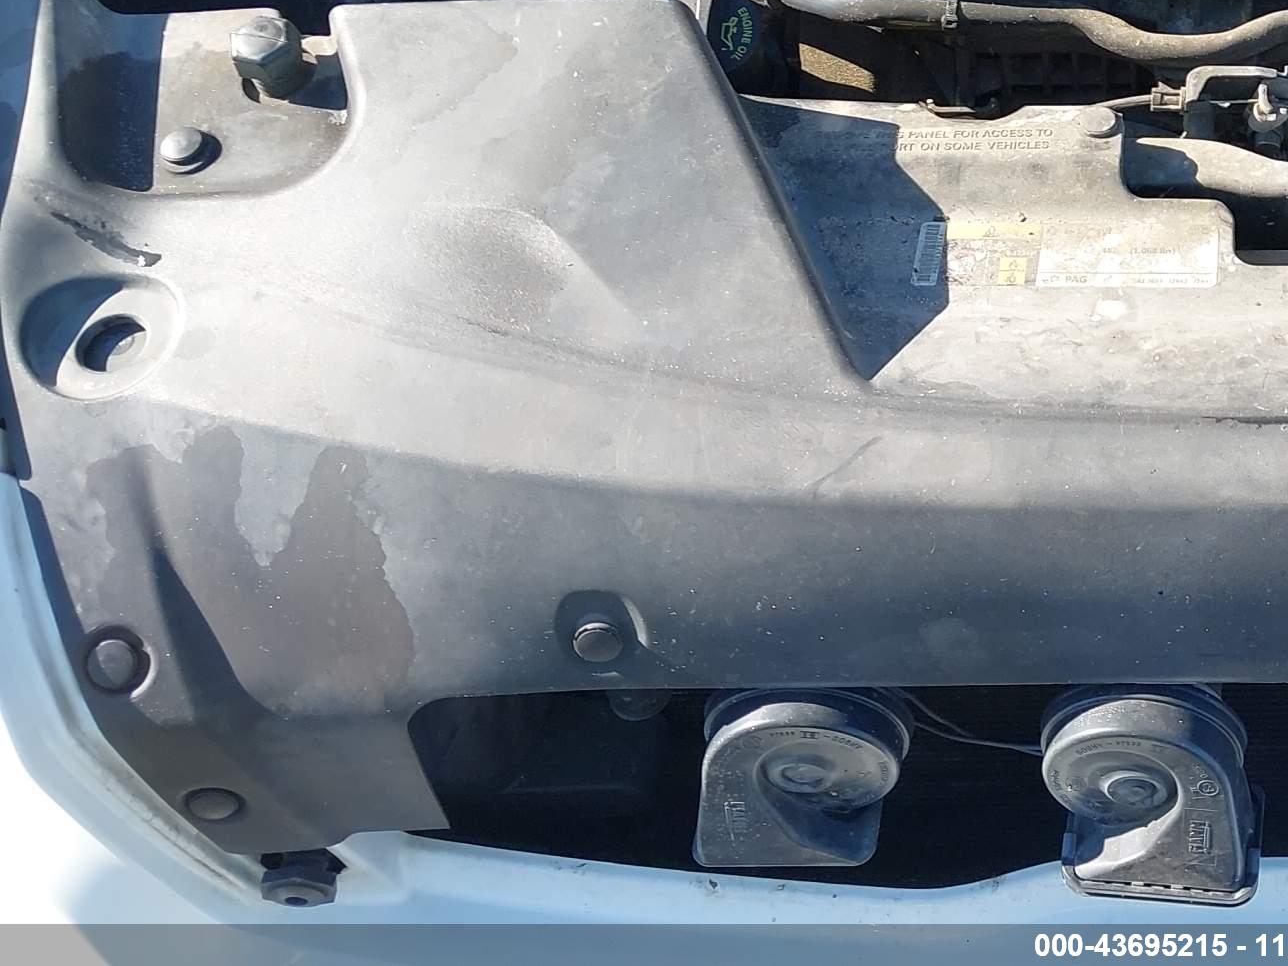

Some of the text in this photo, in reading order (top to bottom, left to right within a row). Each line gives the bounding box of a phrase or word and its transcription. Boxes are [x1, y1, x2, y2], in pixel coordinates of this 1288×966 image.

[730, 6, 753, 61] ENGINE OIL
[908, 130, 950, 139] PANEL
[953, 129, 979, 139] FOR
[982, 129, 1033, 138] ACCESS
[1036, 128, 1053, 138] TO
[920, 142, 940, 151] ON
[944, 142, 982, 151] SOME
[987, 141, 1049, 150] VEHICLES
[1065, 275, 1088, 284] PAG
